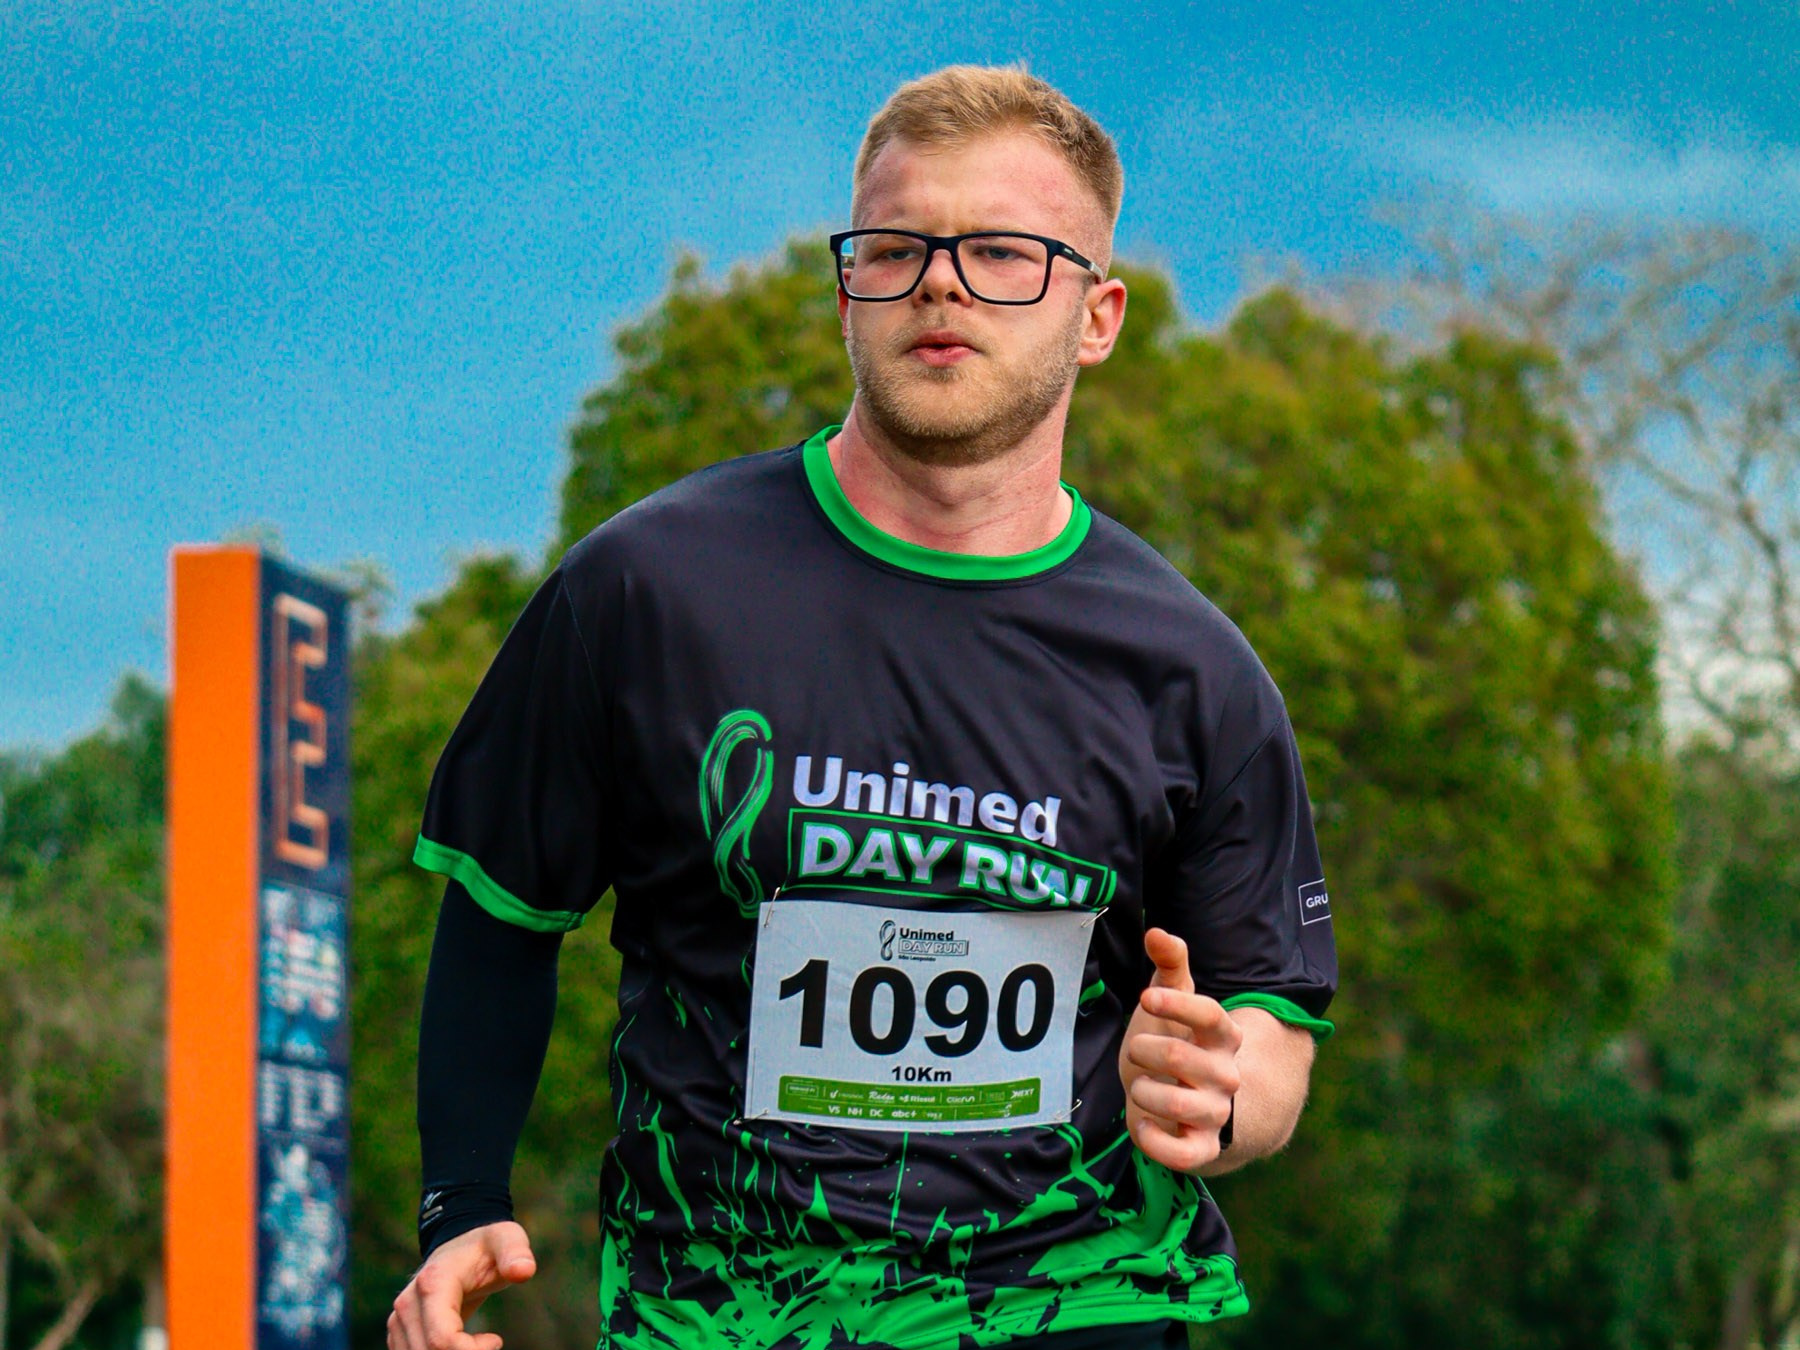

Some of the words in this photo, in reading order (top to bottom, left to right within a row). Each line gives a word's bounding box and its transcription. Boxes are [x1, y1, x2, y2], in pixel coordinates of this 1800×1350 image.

[793, 756, 1061, 847] Unimed
[798, 821, 956, 884] DAY
[958, 841, 1092, 906] RUN
[900, 927, 954, 941] Unimed
[901, 940, 932, 953] DAY
[933, 942, 964, 954] RUN
[779, 958, 1055, 1058] 1090
[891, 1065, 952, 1082] 10Km
[869, 1108, 883, 1117] DC
